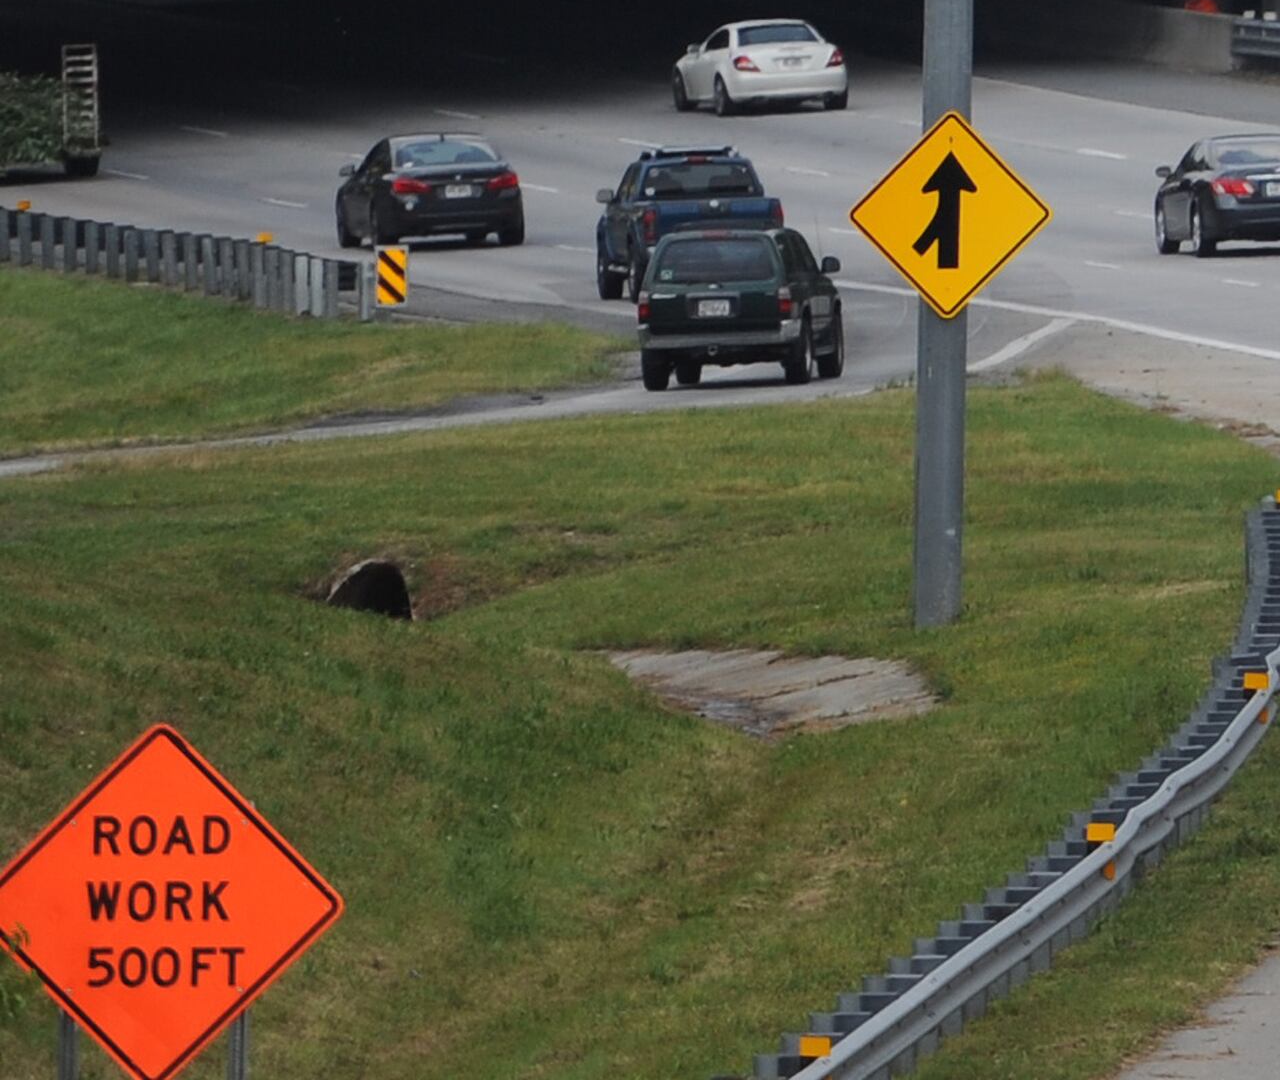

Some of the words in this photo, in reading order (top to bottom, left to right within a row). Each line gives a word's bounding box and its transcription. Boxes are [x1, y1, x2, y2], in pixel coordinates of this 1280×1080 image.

[92, 815, 231, 856] ROAD
[86, 881, 230, 921] WORK
[87, 947, 245, 988] 500FT
